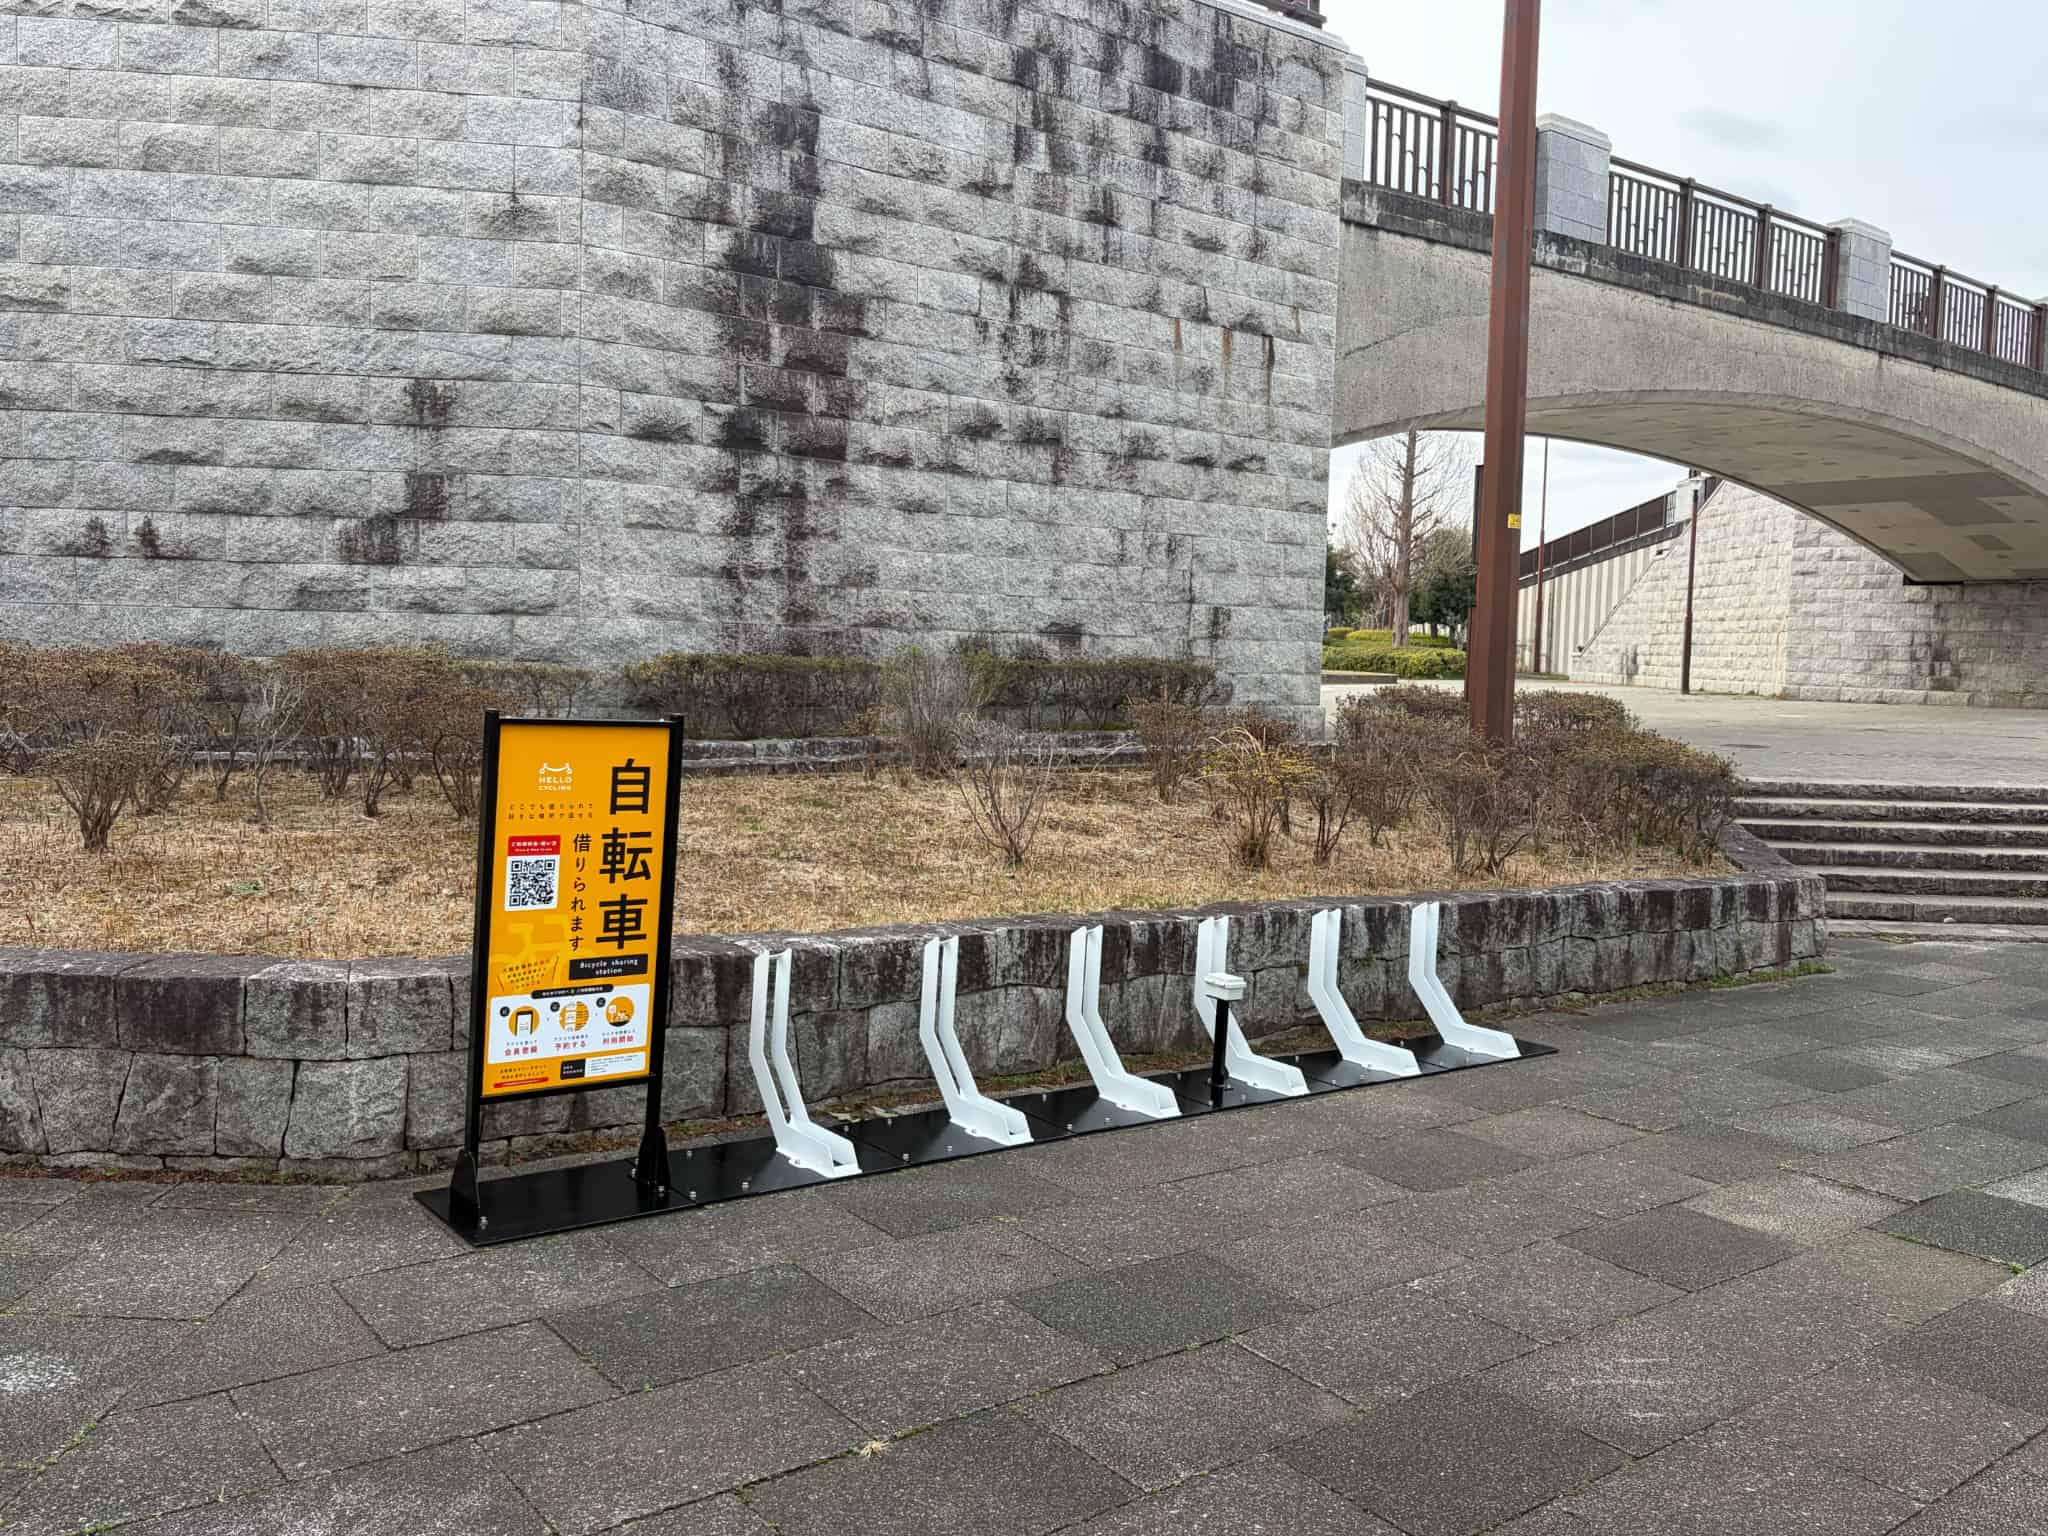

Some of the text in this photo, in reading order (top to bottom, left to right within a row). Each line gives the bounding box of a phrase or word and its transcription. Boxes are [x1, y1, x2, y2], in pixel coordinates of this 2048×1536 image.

[539, 776, 573, 784] HELLO
[595, 758, 653, 950] 自転車
[569, 832, 592, 952] 借りられます
[579, 958, 639, 969] Bicycle sharing
[595, 967, 623, 976] station
